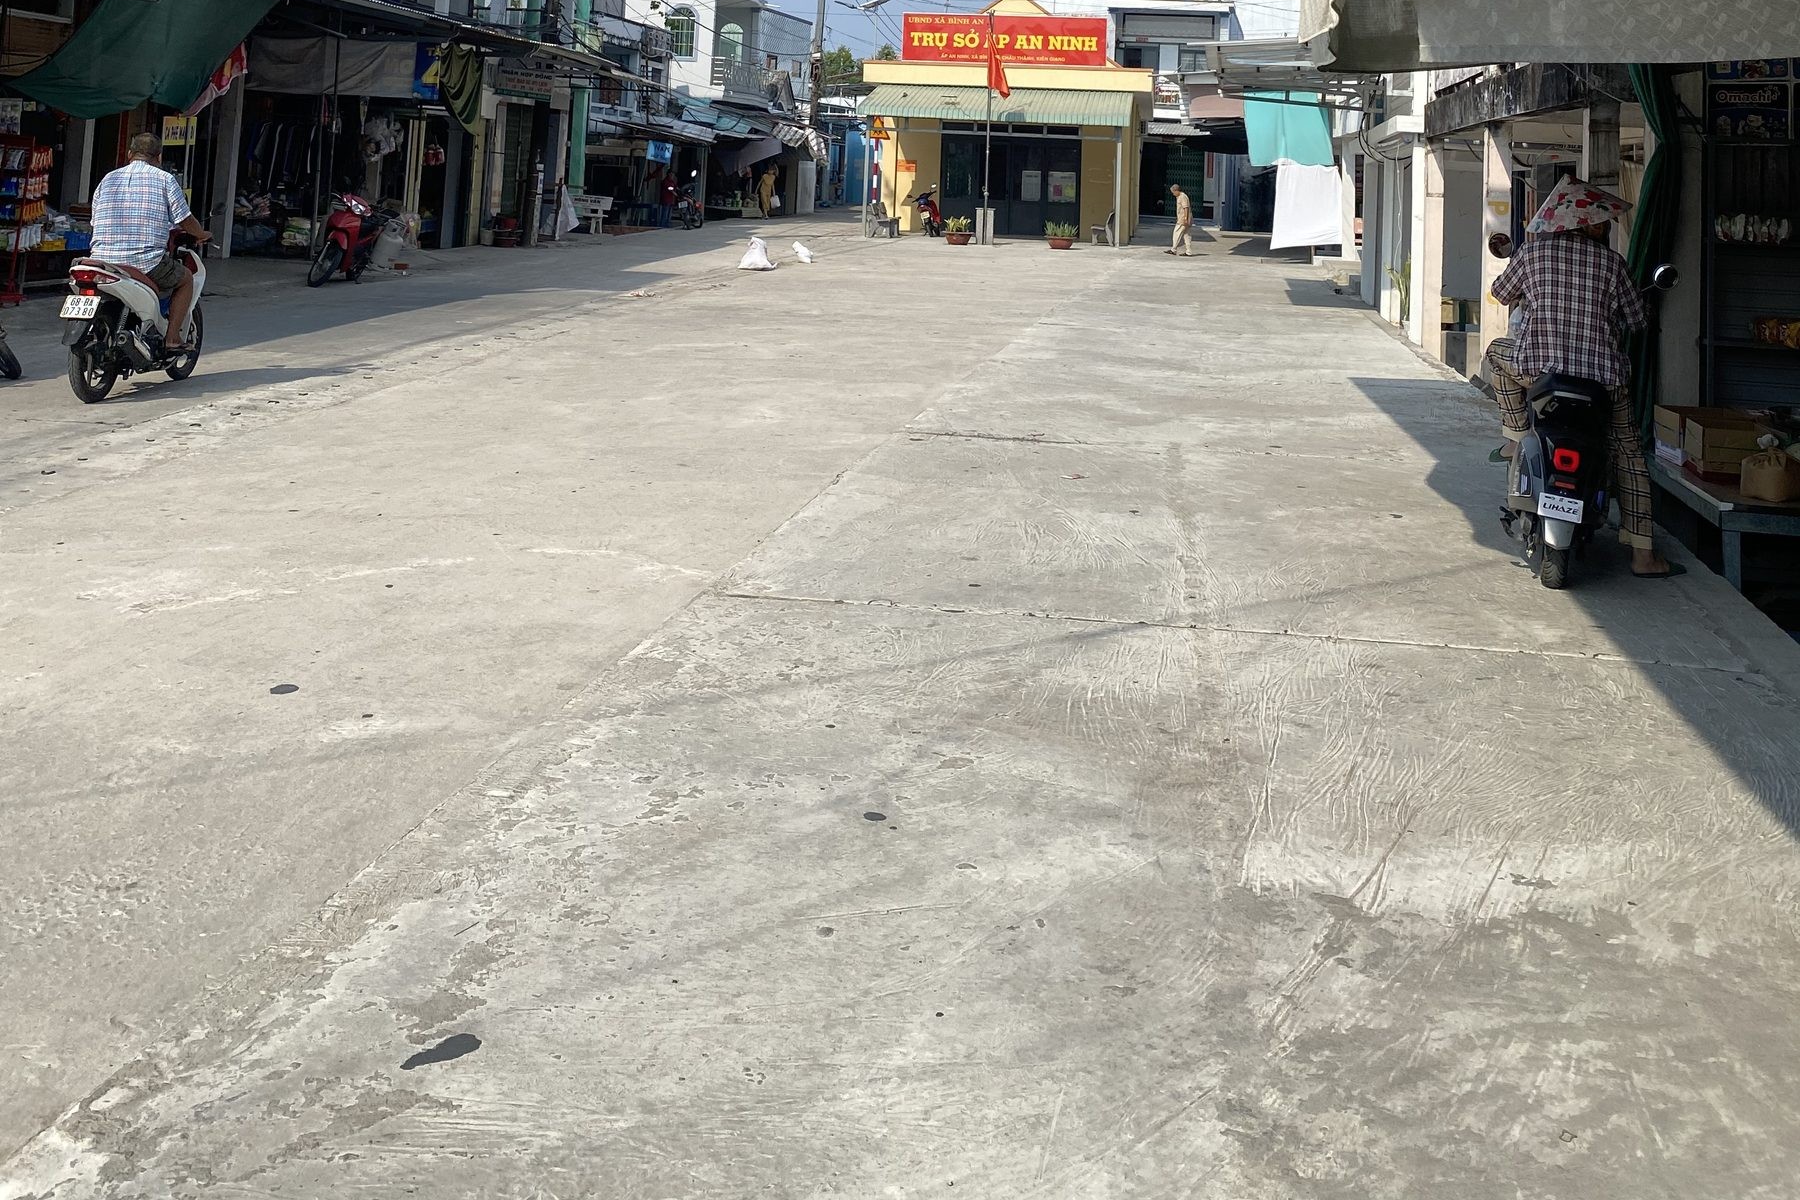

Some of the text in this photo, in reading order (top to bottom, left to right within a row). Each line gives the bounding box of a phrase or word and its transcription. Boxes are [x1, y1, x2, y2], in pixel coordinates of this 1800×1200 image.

[934, 16, 946, 24] XÃ
[948, 16, 970, 25] BÌNH
[910, 31, 948, 51] TRỤ
[953, 28, 980, 49] SỞ
[1014, 34, 1043, 50] AN
[1047, 35, 1098, 52] NINH
[1716, 89, 1772, 103] Omachi
[1543, 502, 1579, 516] LIHAZE
